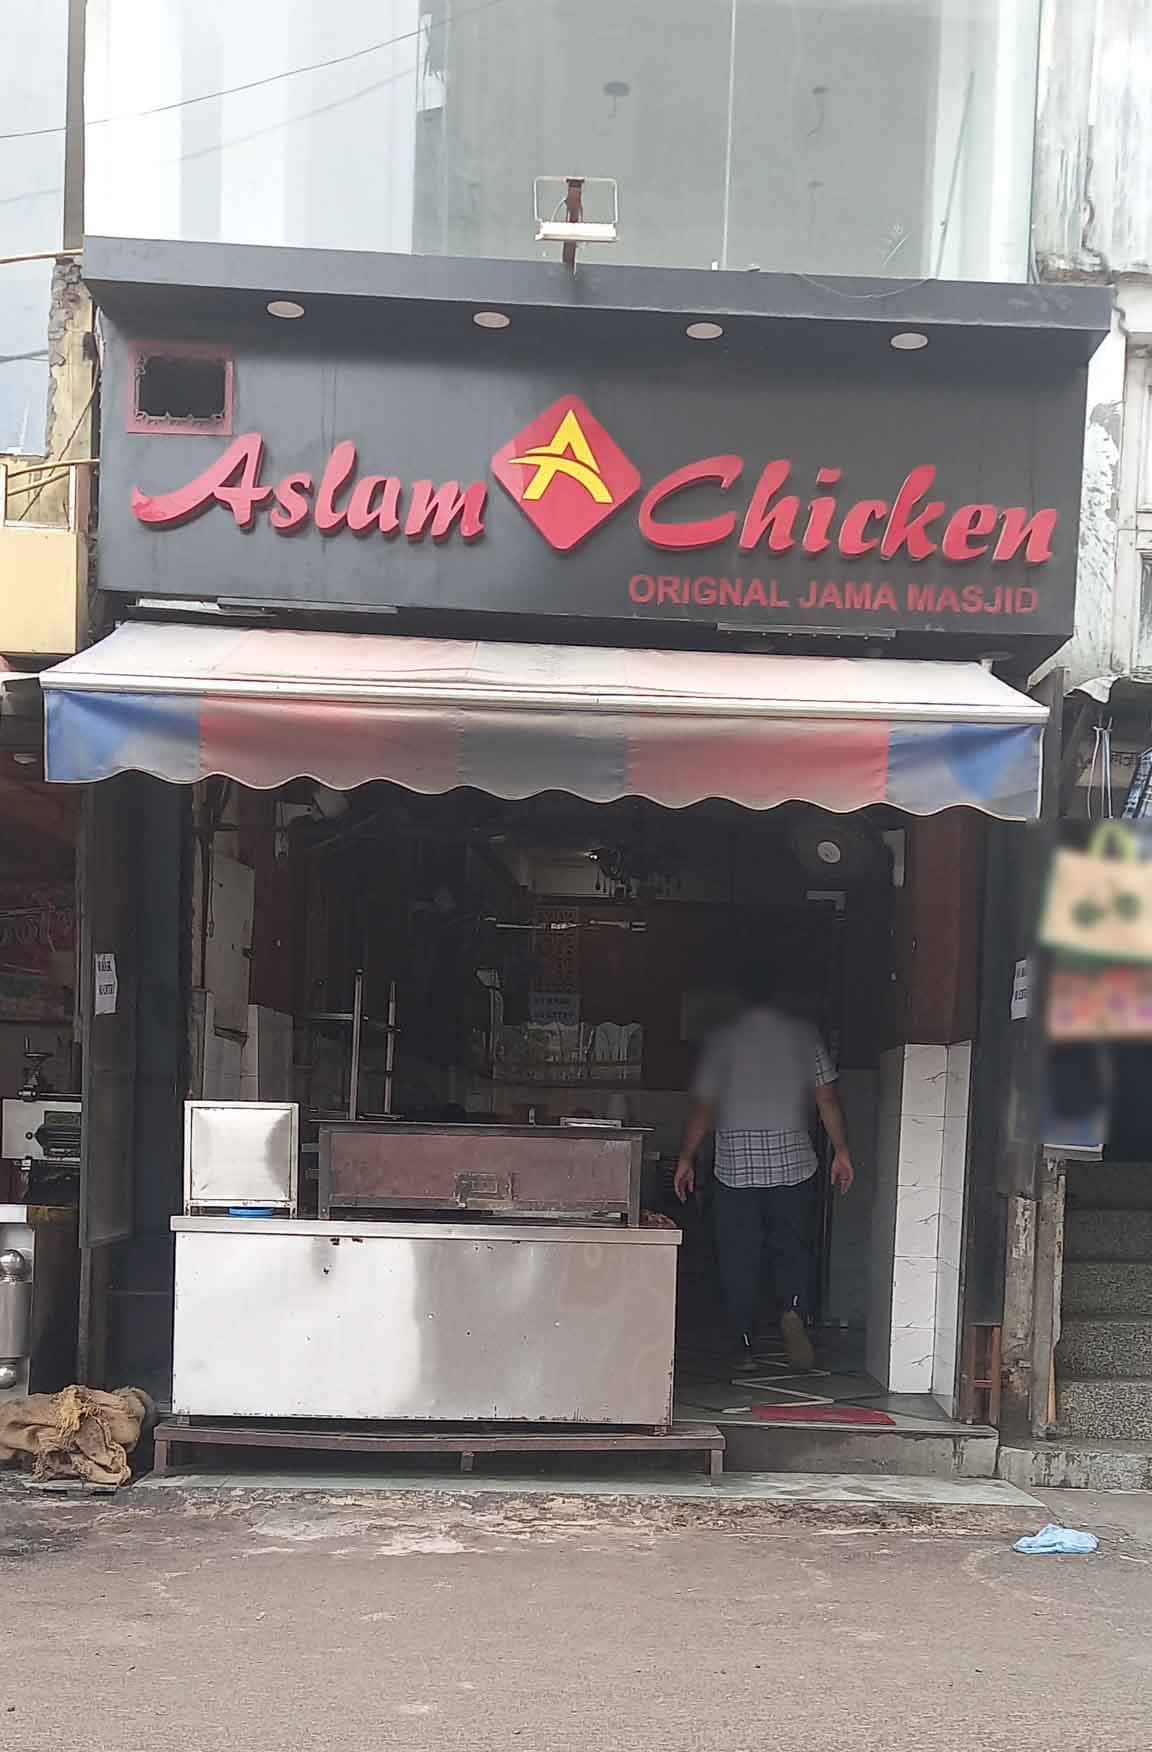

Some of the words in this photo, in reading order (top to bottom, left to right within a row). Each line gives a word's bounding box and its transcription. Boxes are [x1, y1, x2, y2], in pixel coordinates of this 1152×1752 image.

[131, 431, 489, 540] Aslam
[638, 454, 1057, 566] Chicken
[628, 575, 790, 608] ORIGNAL
[797, 580, 898, 612] JAMA
[906, 583, 1041, 615] MASJID
